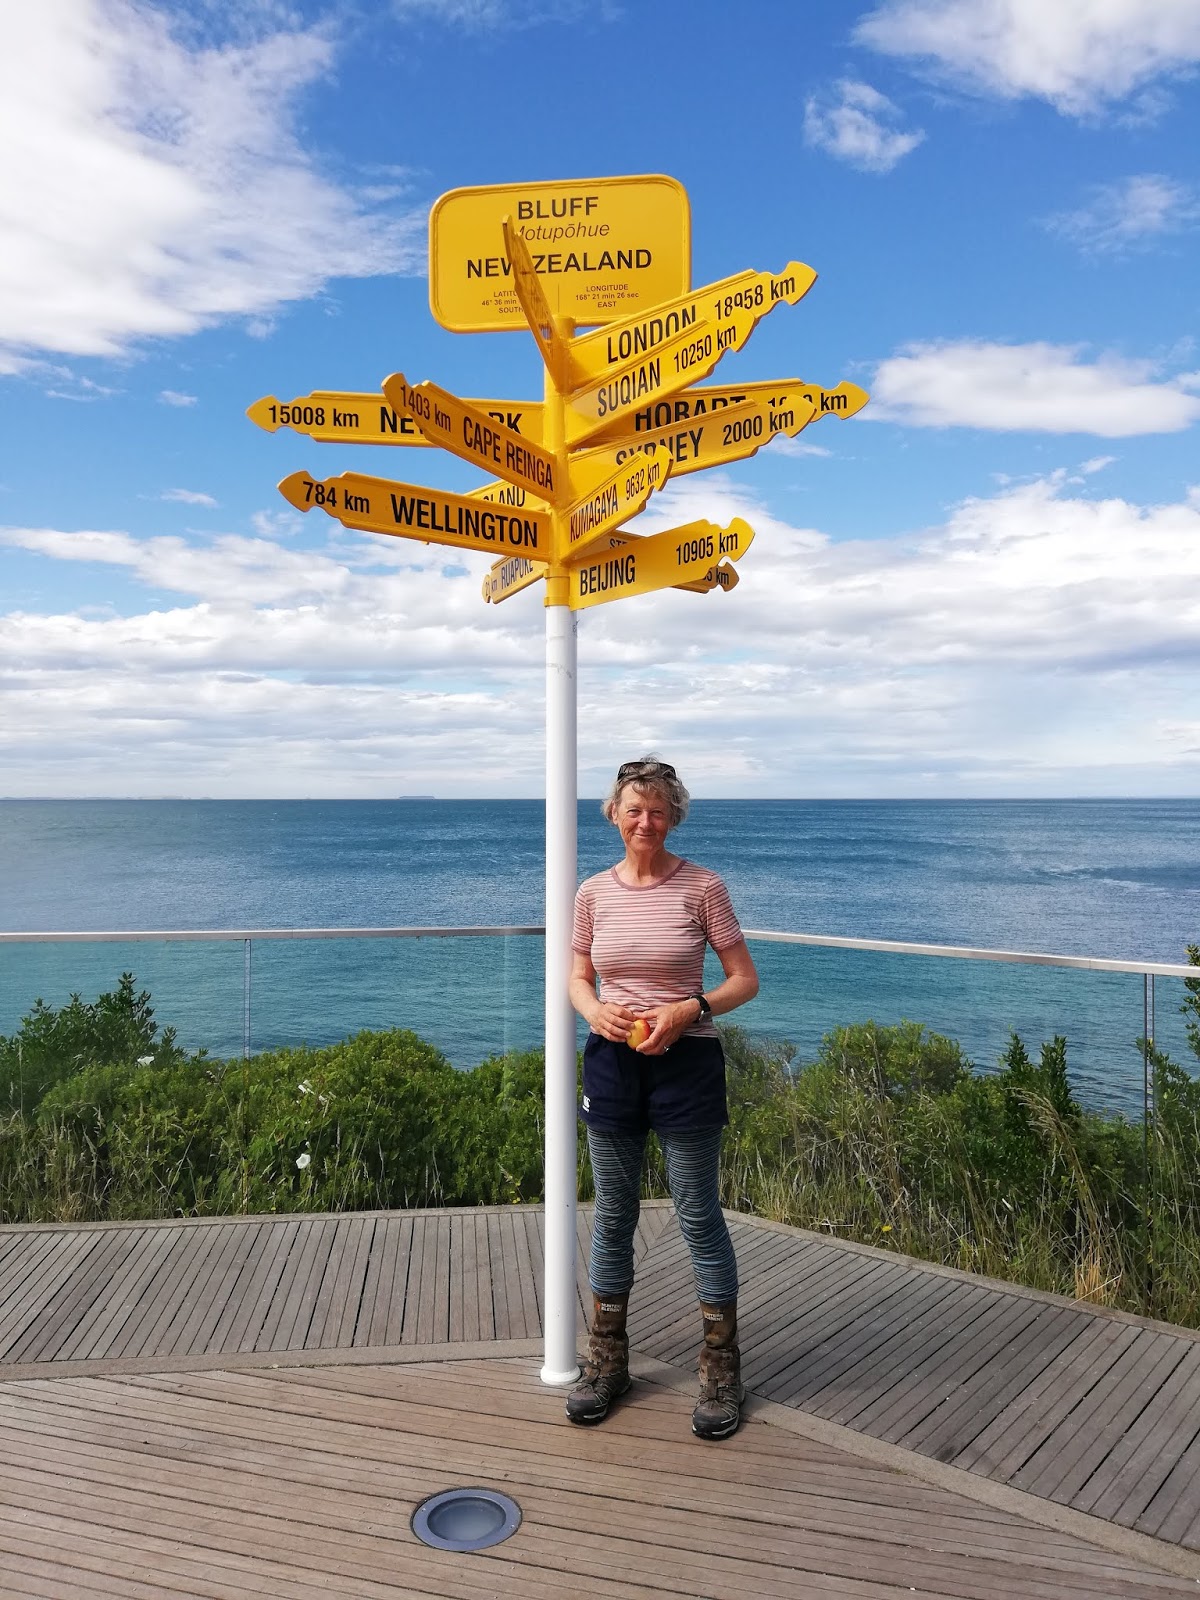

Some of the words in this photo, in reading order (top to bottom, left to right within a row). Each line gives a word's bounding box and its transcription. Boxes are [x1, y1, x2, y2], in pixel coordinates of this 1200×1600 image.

[518, 196, 599, 220] BLUFF
[532, 249, 652, 273] ZEALAND
[493, 290, 517, 298] LATITU
[586, 284, 629, 292] LONGITUDE
[607, 304, 696, 364] LONDON
[770, 276, 795, 300] km
[597, 357, 661, 417] SUQIAN
[673, 334, 712, 373] 10250
[717, 325, 736, 351] km
[268, 404, 325, 426] 15008
[333, 408, 359, 428] km
[380, 406, 424, 435] NE
[635, 395, 746, 432] HOBA
[820, 392, 848, 412] km
[723, 415, 763, 446] 2000
[769, 410, 795, 433] km
[400, 384, 431, 420] 1403
[434, 403, 452, 433] km
[463, 416, 501, 464] CAPE
[506, 440, 554, 492] REINGA
[302, 481, 338, 508] 784
[344, 490, 370, 514] km
[390, 493, 539, 548] WELLINGTON
[570, 483, 619, 543] KUMAGAYA
[626, 468, 645, 501] 9632
[647, 462, 660, 486] km
[580, 554, 636, 596] BEIJING
[676, 535, 714, 566] 10905
[719, 532, 738, 554] km
[716, 567, 729, 585] km
